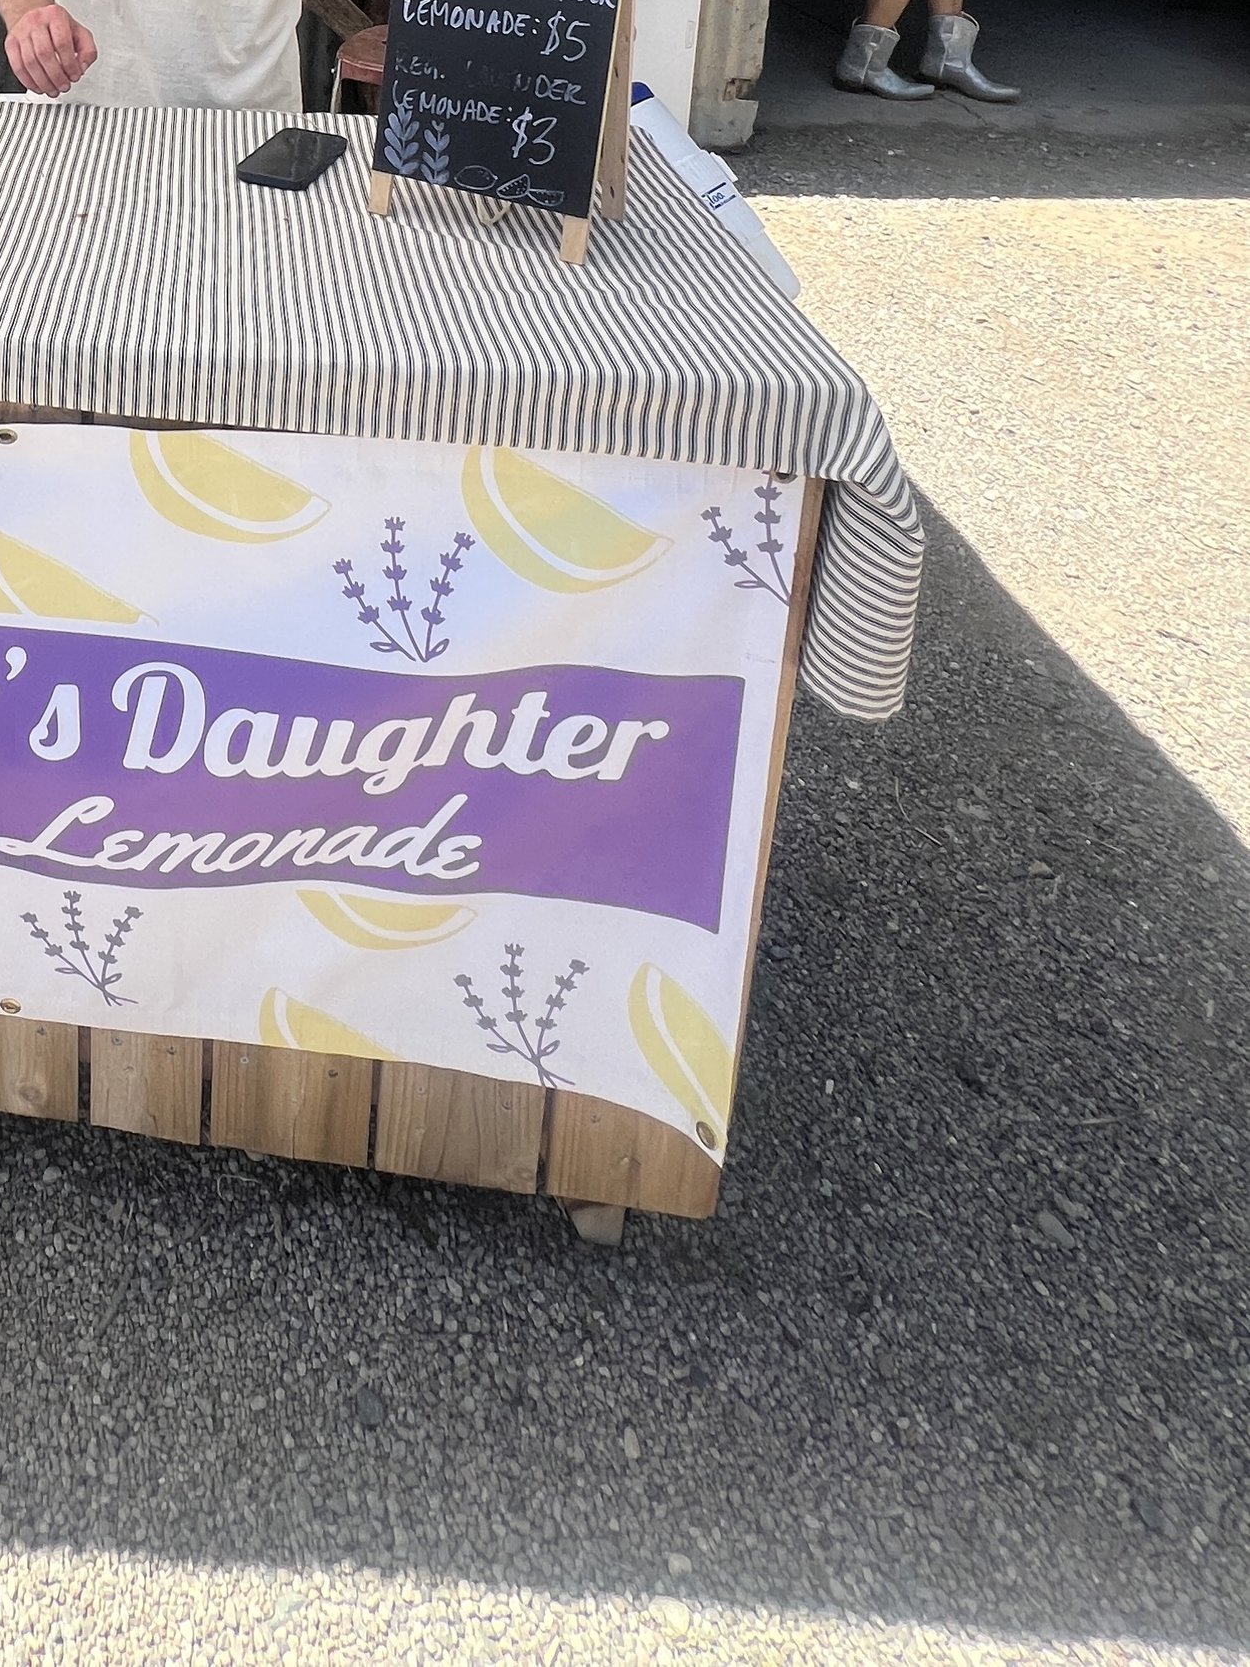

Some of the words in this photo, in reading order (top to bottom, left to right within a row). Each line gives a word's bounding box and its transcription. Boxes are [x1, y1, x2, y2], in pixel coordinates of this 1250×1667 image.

[540, 10, 591, 62] $5
[392, 80, 514, 124] LEMONADE:
[511, 107, 558, 165] $3
[110, 661, 670, 795] Daughter
